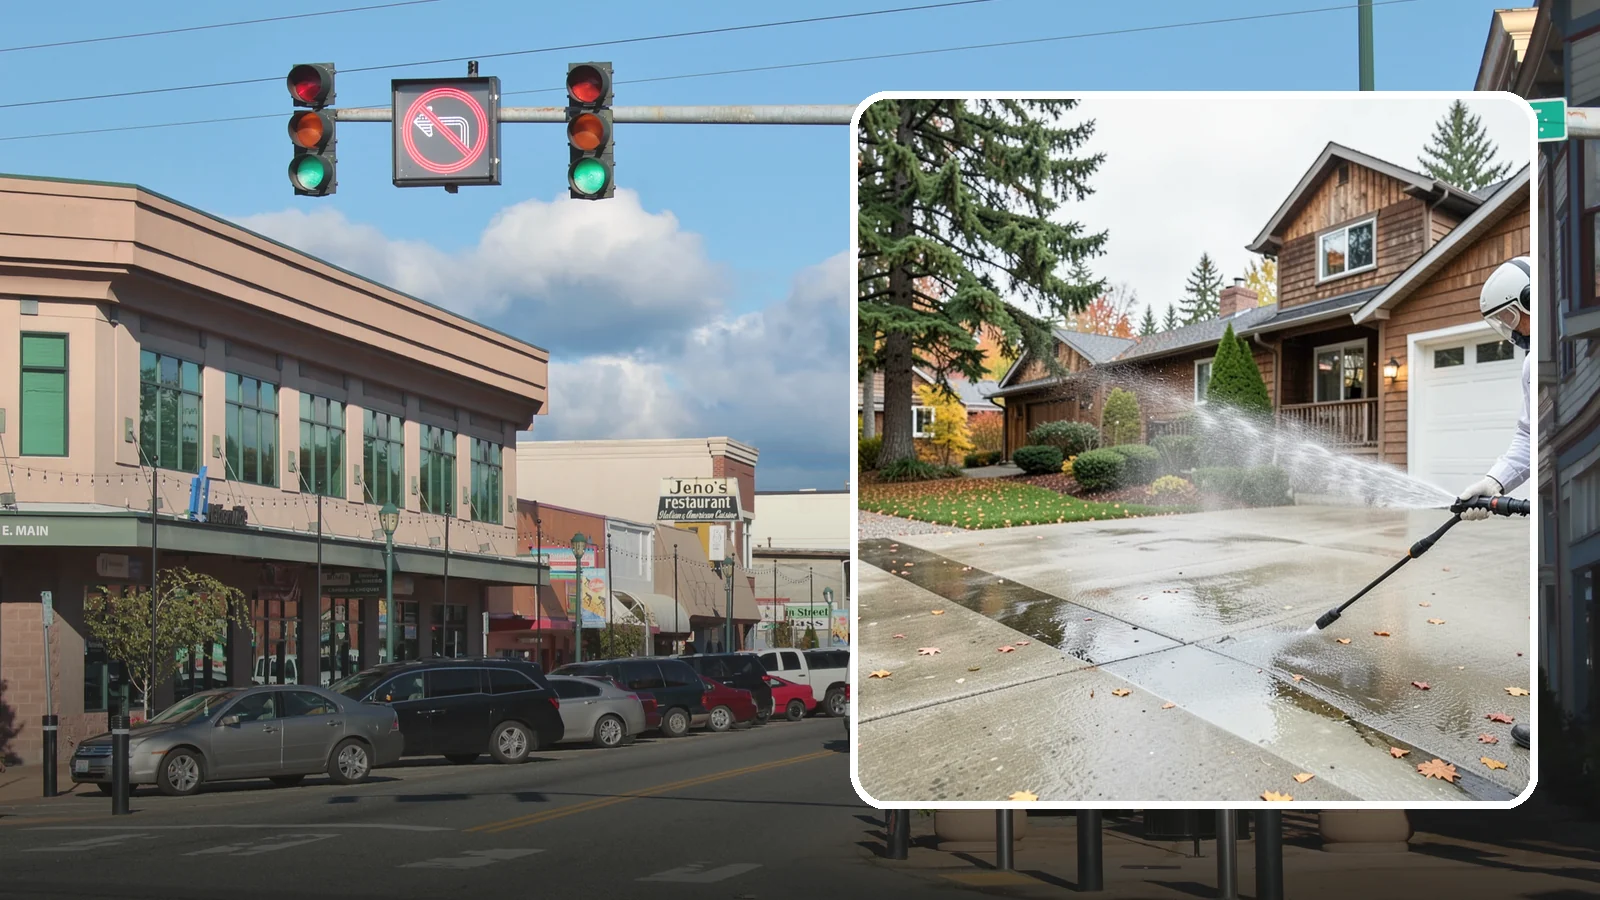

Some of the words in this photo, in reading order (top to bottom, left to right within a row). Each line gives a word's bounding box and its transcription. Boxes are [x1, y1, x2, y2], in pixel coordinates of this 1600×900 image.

[670, 480, 727, 494] Jeno's
[665, 496, 731, 509] restaurant
[658, 510, 681, 519] Italian
[685, 510, 714, 519] American
[714, 509, 738, 519] Cuisine
[2, 525, 13, 536] E.
[16, 525, 49, 536] MAIN
[797, 607, 829, 616] Street
